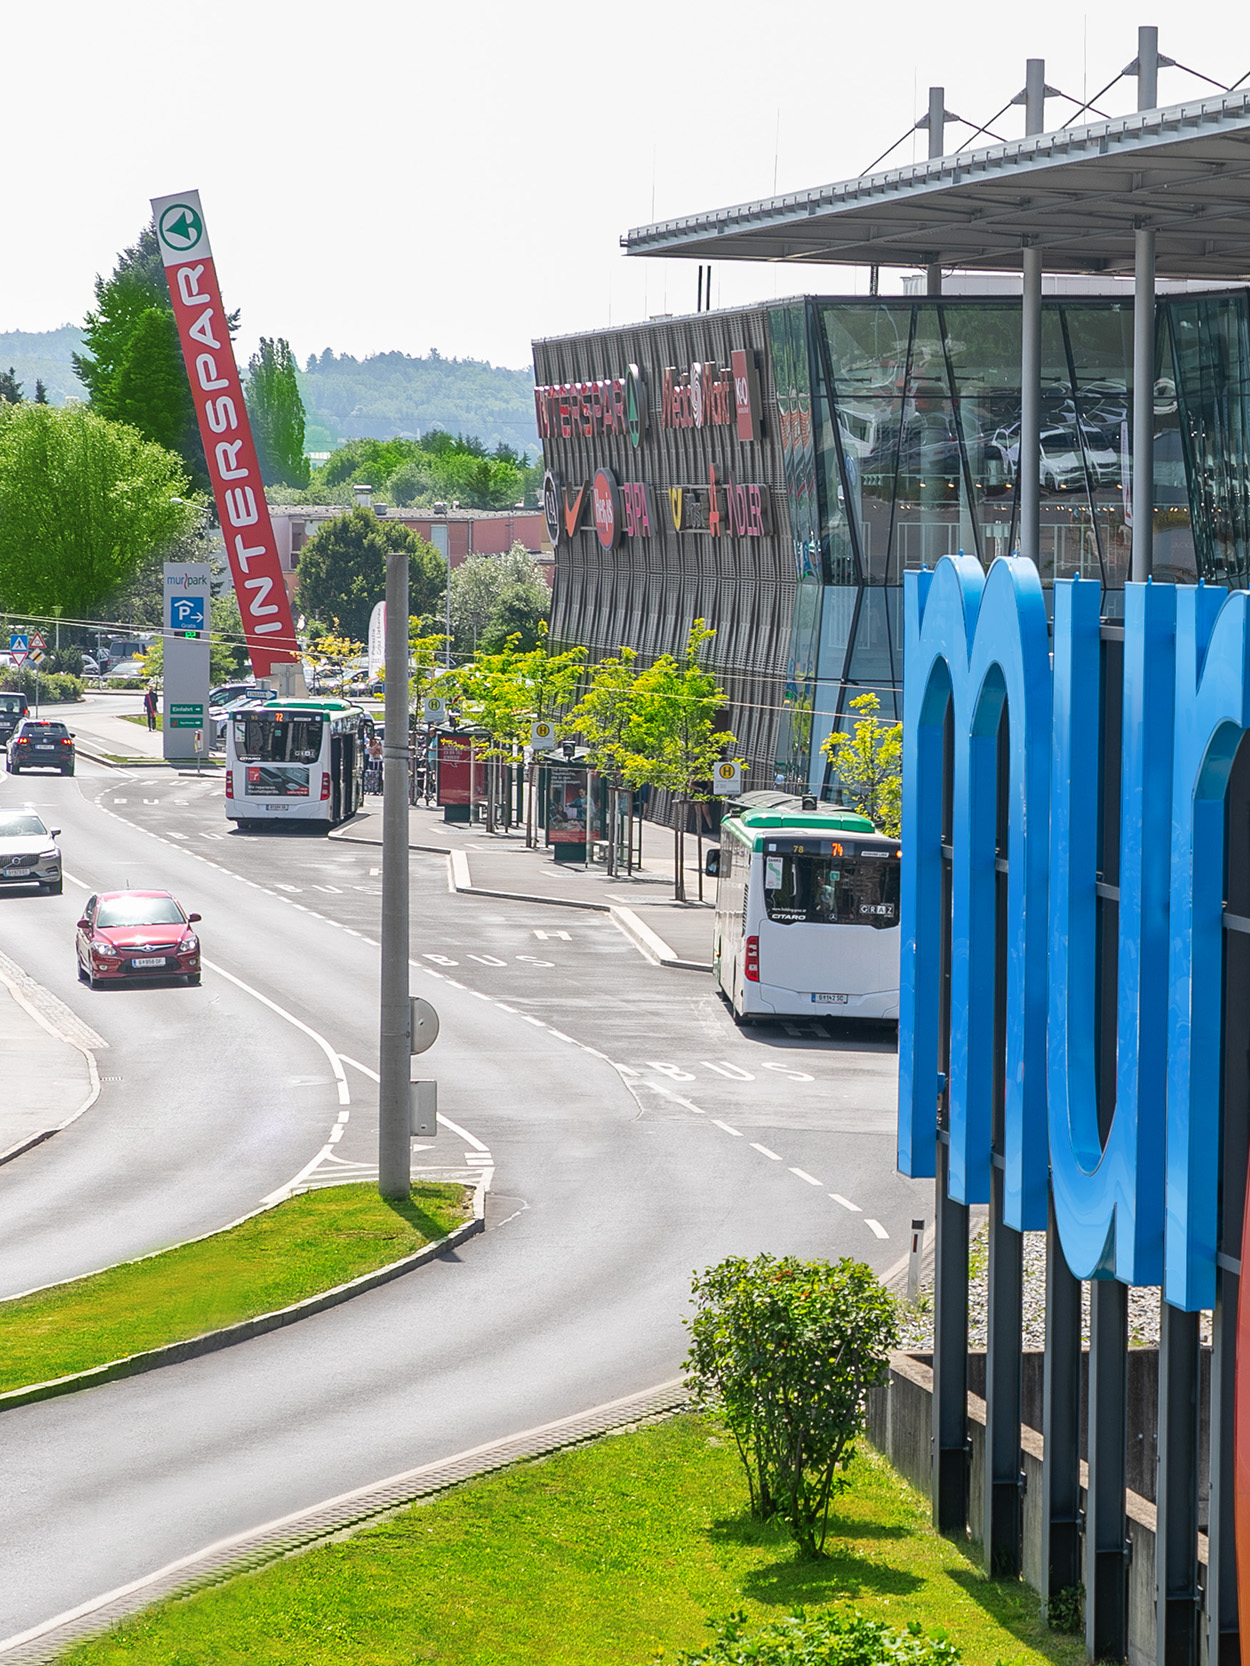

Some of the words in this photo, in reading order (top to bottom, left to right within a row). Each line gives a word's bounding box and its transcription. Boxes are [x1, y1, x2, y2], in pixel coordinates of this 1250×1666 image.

[534, 379, 627, 439] INTERSPAR
[177, 264, 283, 635] INTERSPAR
[624, 483, 651, 537] BIPA
[728, 473, 765, 538] ADLER
[178, 606, 191, 621] P
[275, 712, 284, 722] 72
[793, 845, 805, 854] 78
[831, 842, 844, 857] 74
[274, 884, 383, 895] BUS
[861, 904, 892, 914] GRAZ
[771, 913, 807, 921] CITARO
[421, 953, 556, 968] BUS
[645, 1061, 816, 1083] BUS
